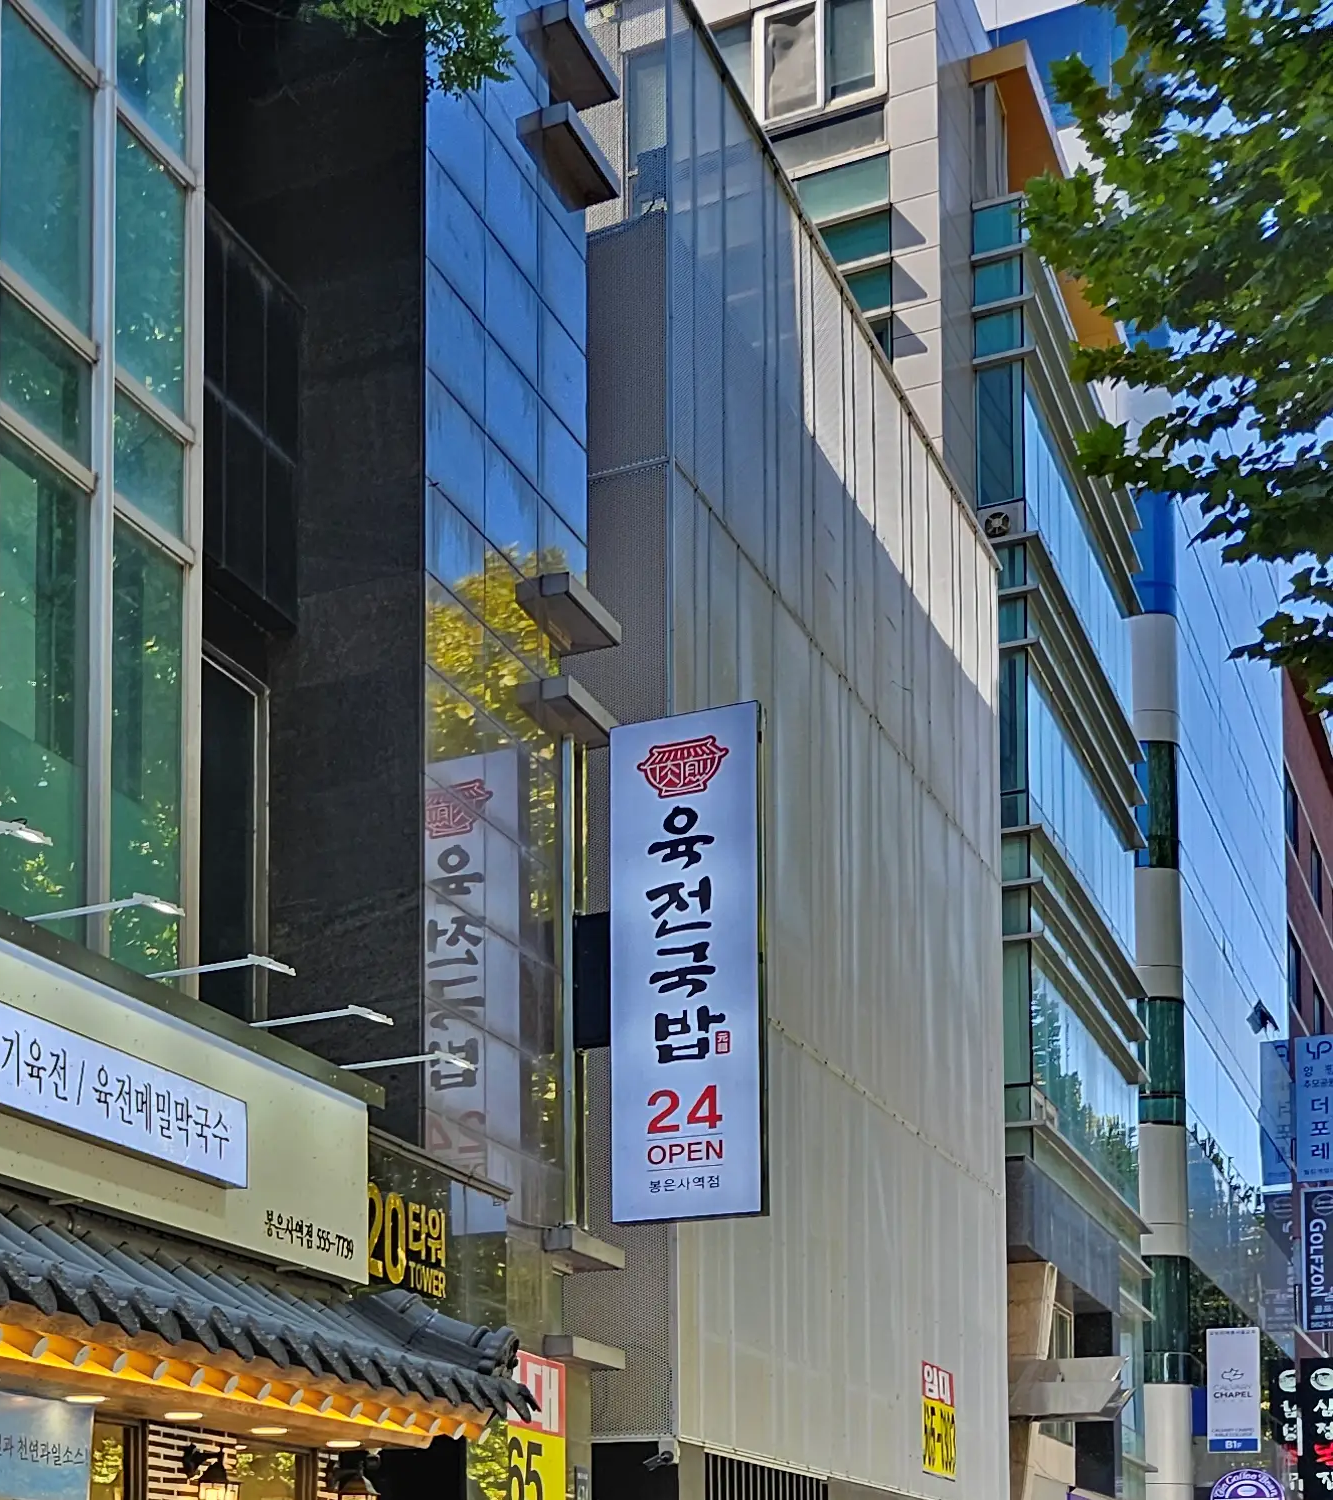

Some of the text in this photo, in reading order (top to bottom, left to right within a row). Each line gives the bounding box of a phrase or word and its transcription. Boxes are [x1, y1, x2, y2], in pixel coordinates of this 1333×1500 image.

[646, 806, 726, 1064] 육전국밥
[93, 1064, 232, 1160] 육전메밀막국수
[647, 1084, 723, 1134] 24
[647, 1140, 723, 1165] OPEN
[649, 1175, 720, 1194] 봉은사역점
[265, 1209, 354, 1261] 봉은사역점 555-7739
[408, 1202, 446, 1268] 타워
[409, 1261, 446, 1299] TOWER
[1309, 1218, 1327, 1298] GOLFZON
[1213, 1391, 1252, 1399] CHAPEL
[1225, 1441, 1242, 1449] B1F
[1226, 1472, 1257, 1485] Coffee
